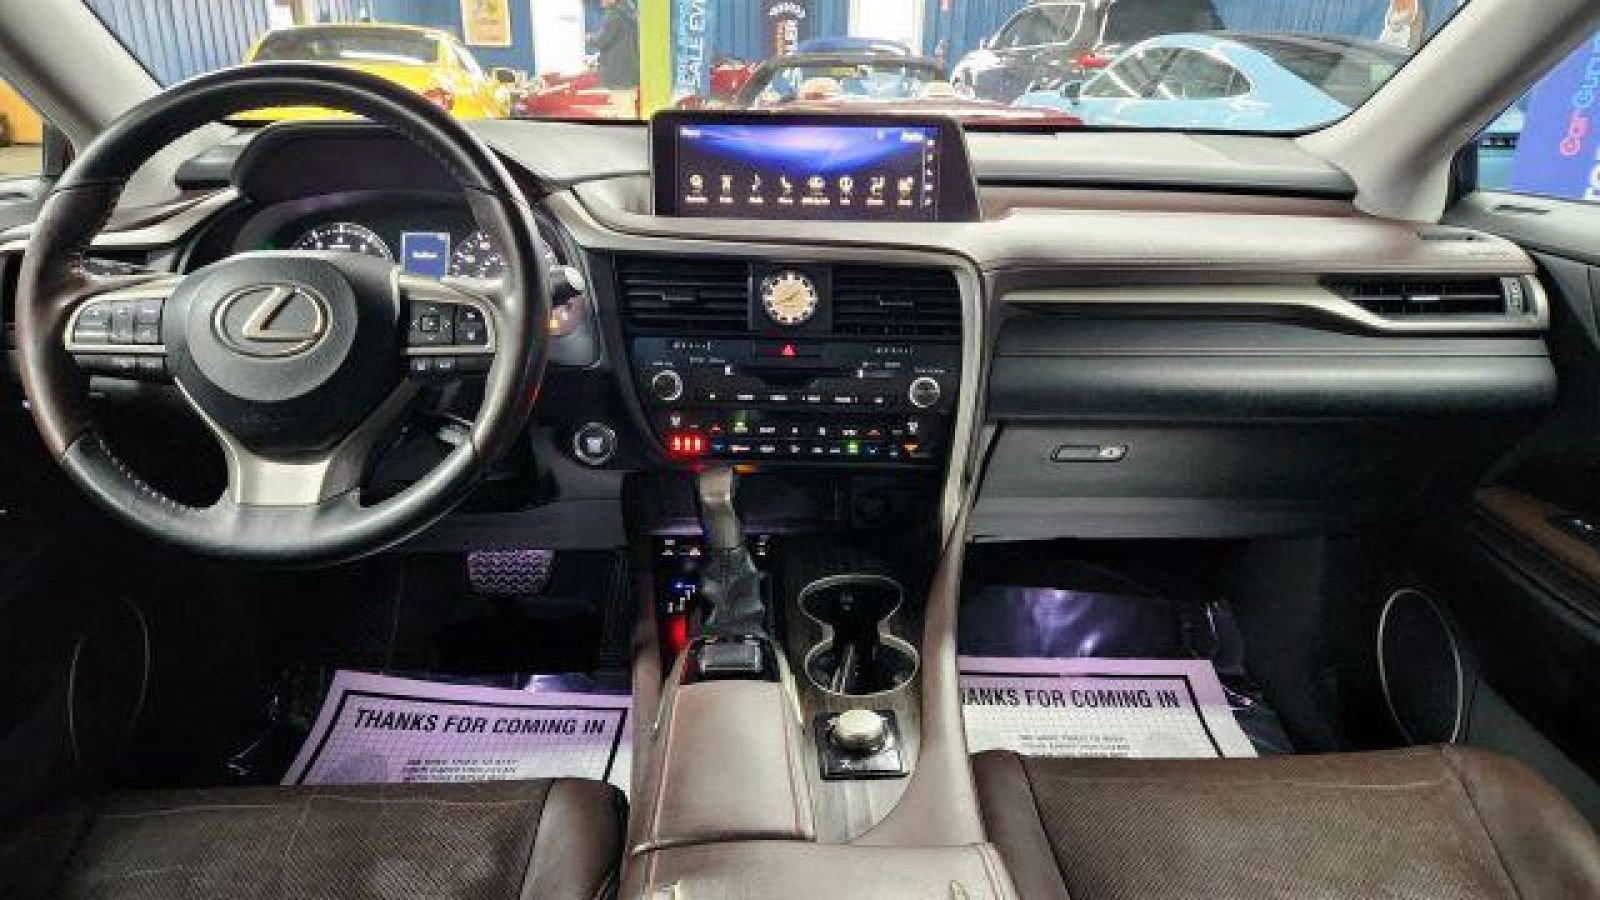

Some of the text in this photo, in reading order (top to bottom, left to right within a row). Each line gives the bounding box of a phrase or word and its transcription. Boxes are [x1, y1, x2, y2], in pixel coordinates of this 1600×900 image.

[1024, 689, 1066, 708] FOR
[1070, 689, 1153, 708] COMING
[1155, 689, 1180, 708] IN
[354, 708, 606, 736] THANKS FOR COMING IN
